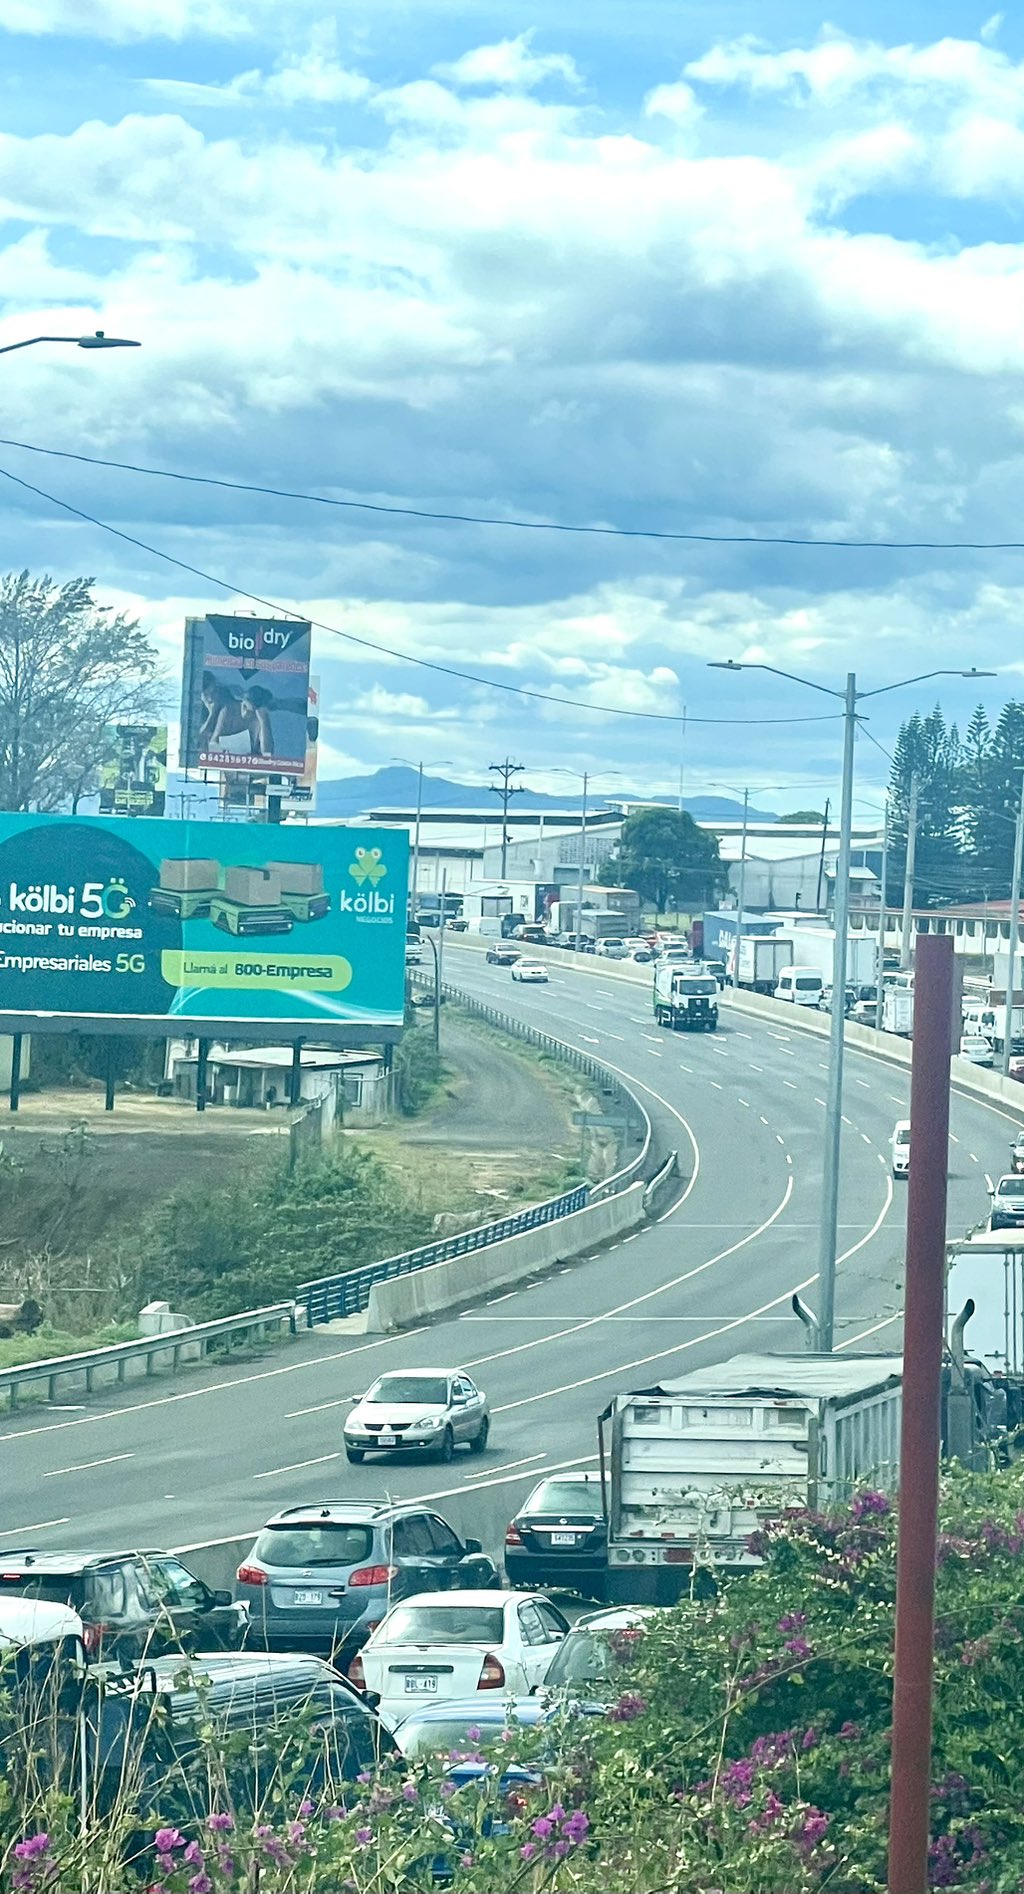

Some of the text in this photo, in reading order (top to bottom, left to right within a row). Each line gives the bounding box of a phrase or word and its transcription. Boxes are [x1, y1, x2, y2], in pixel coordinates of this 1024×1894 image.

[228, 628, 291, 652] bio dry
[9, 882, 76, 914] kölbi
[340, 889, 395, 914] kölbi
[0, 920, 143, 941] cionar tu empresa
[115, 953, 146, 973] 5G
[218, 963, 228, 974] al
[234, 963, 333, 980] 800-Empresa
